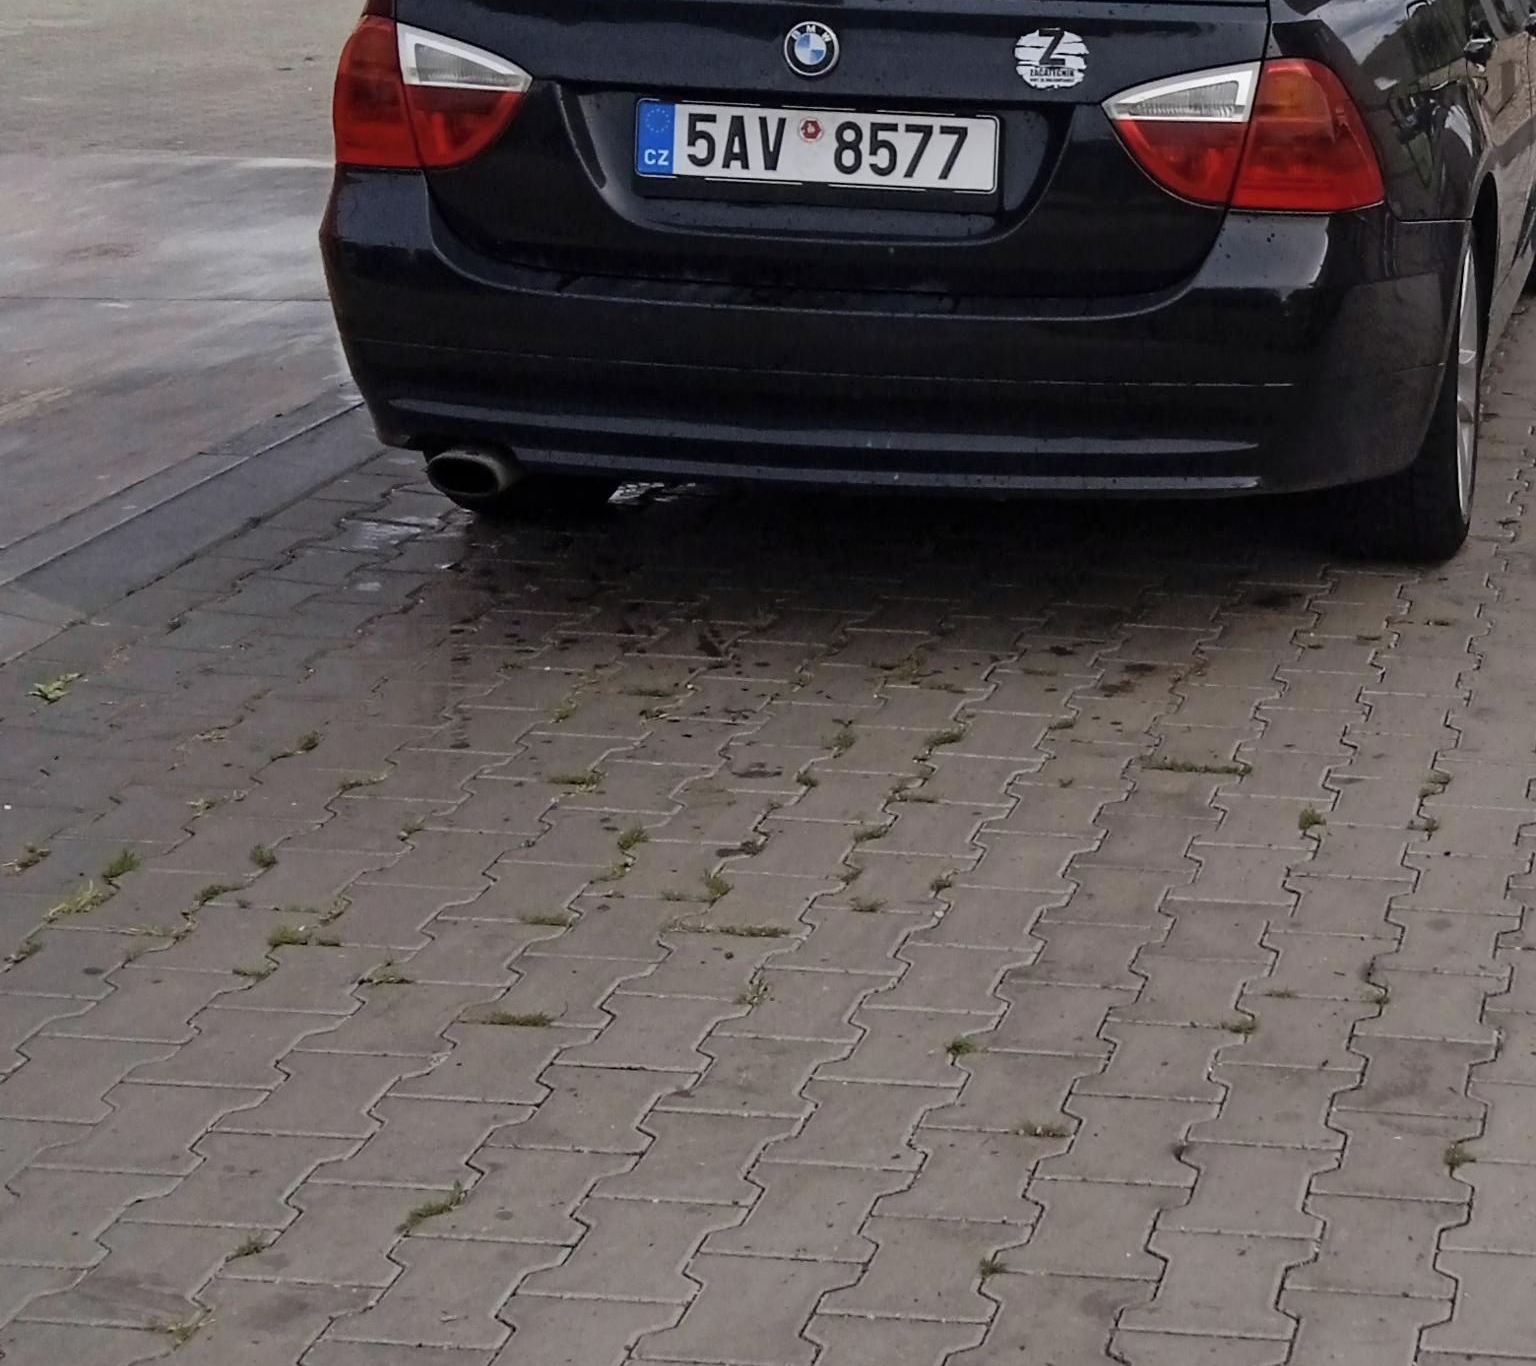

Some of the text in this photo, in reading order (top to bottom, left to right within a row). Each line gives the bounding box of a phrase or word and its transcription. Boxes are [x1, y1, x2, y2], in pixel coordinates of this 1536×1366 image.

[790, 23, 832, 43] BMW
[686, 112, 970, 181] 5AV 8577
[643, 148, 670, 166] CZ
